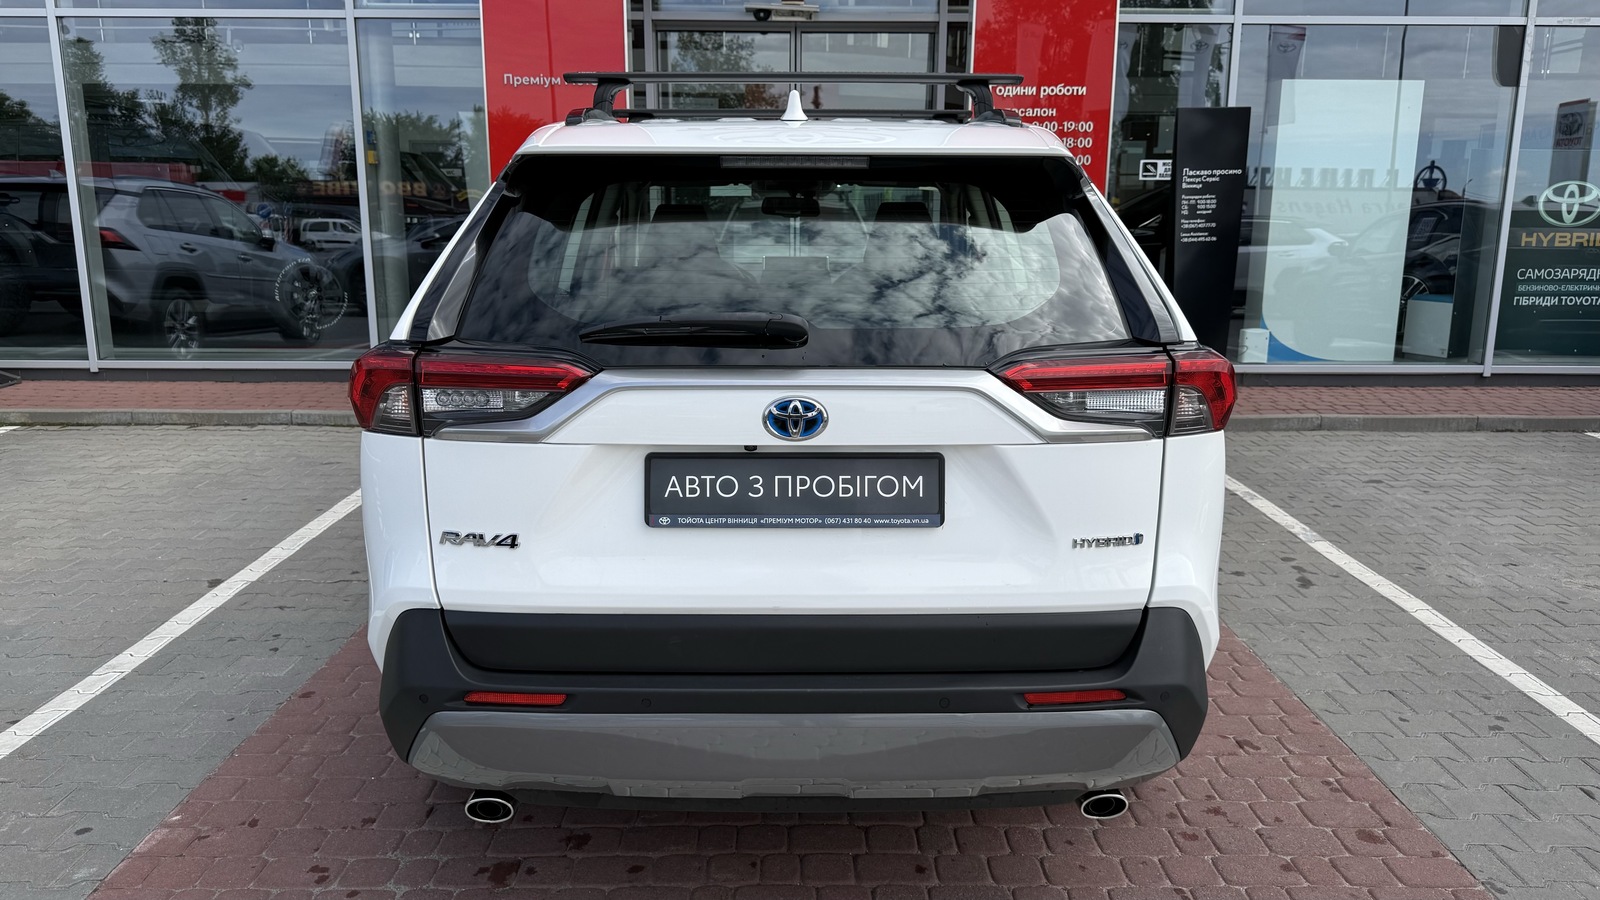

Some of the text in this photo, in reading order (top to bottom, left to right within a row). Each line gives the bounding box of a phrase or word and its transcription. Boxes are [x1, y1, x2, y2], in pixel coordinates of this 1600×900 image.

[503, 73, 561, 88] Преміум
[1040, 84, 1087, 98] роботи
[1061, 137, 1093, 148] 18:00
[1182, 168, 1242, 176] Ласкаво просимо
[1513, 296, 1560, 306] ГІБРИДИ
[664, 475, 923, 498] АВТО З ПРОБІГОМ
[678, 516, 704, 524] ТОЙОТА
[705, 517, 727, 525] ЦЕНТР
[727, 517, 758, 525] ВІННИЦЯ
[824, 517, 842, 525] (067)
[874, 517, 930, 525] www.toyota.vn.ua
[439, 531, 520, 549] RAV4
[1072, 536, 1133, 549] HYBRID
